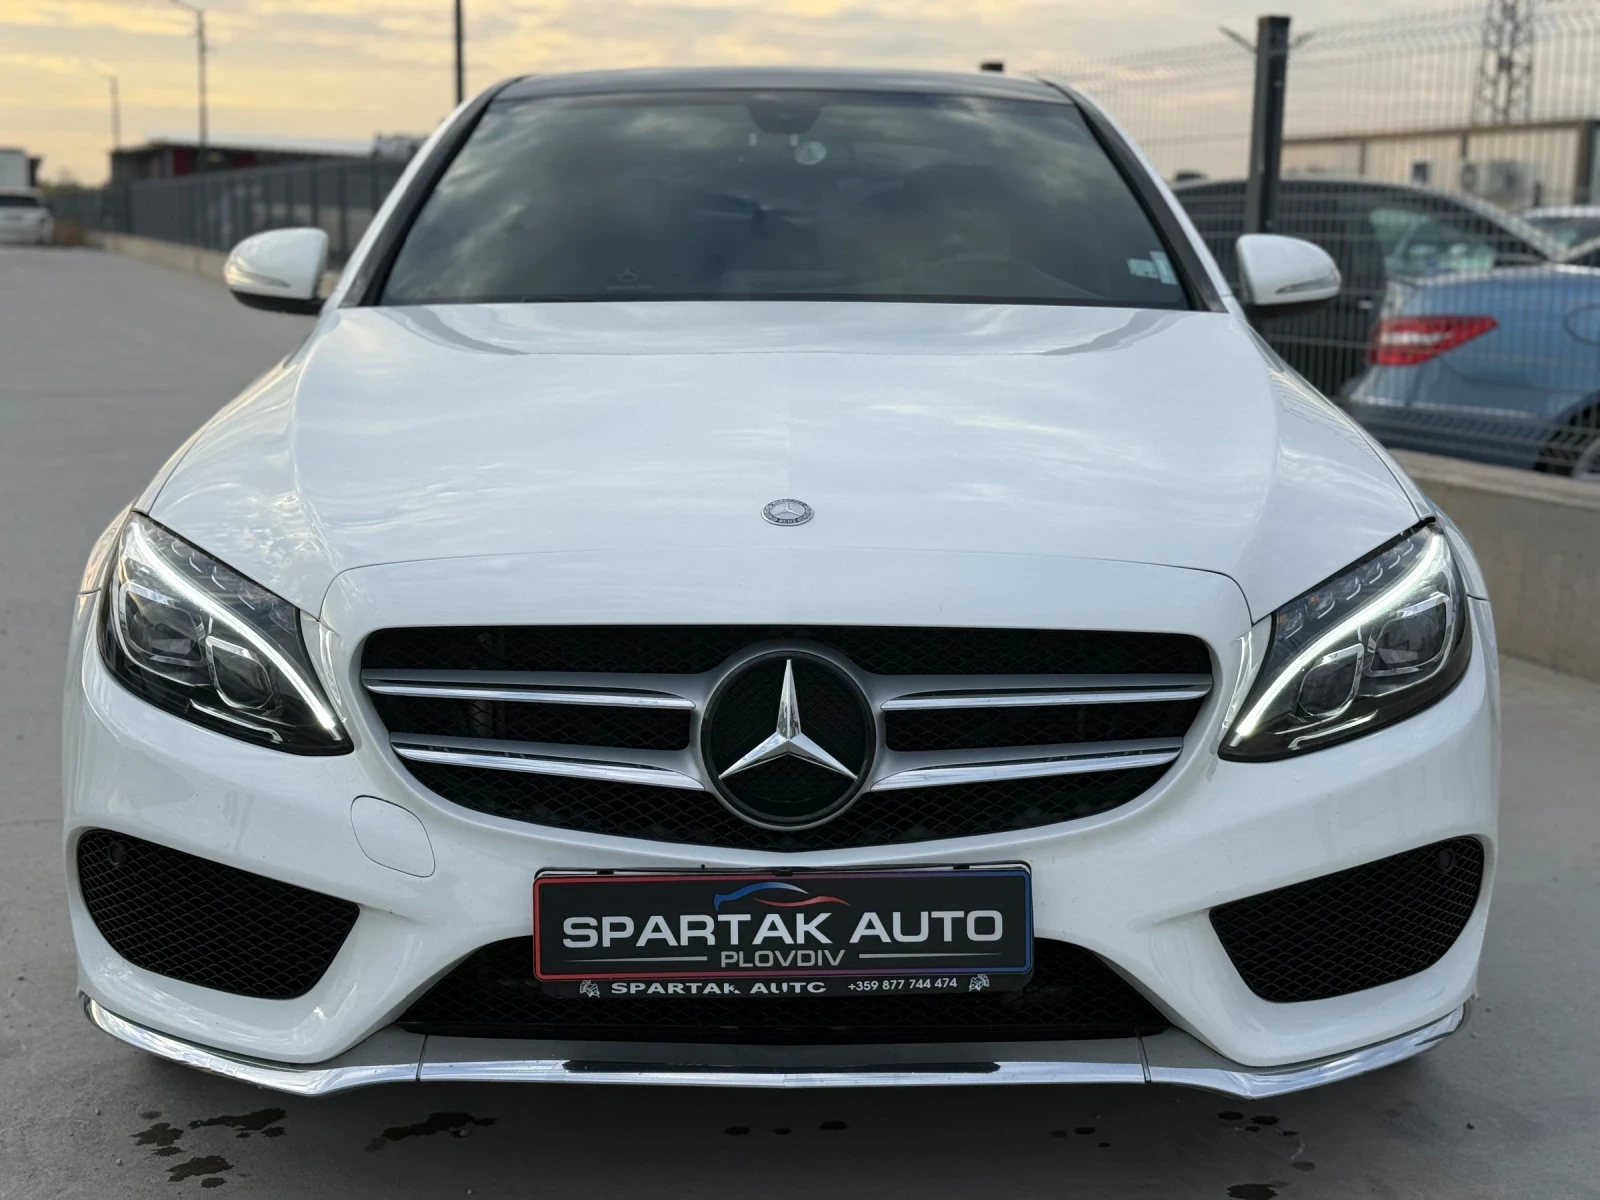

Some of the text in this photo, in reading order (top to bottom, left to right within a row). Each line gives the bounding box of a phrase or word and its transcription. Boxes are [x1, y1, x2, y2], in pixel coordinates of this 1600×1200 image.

[562, 909, 1003, 948] SPARTAK AUTO
[720, 949, 845, 968] PLOVDIV
[611, 982, 741, 994] SPARTAK
[848, 977, 958, 991] +359 877 744 474
